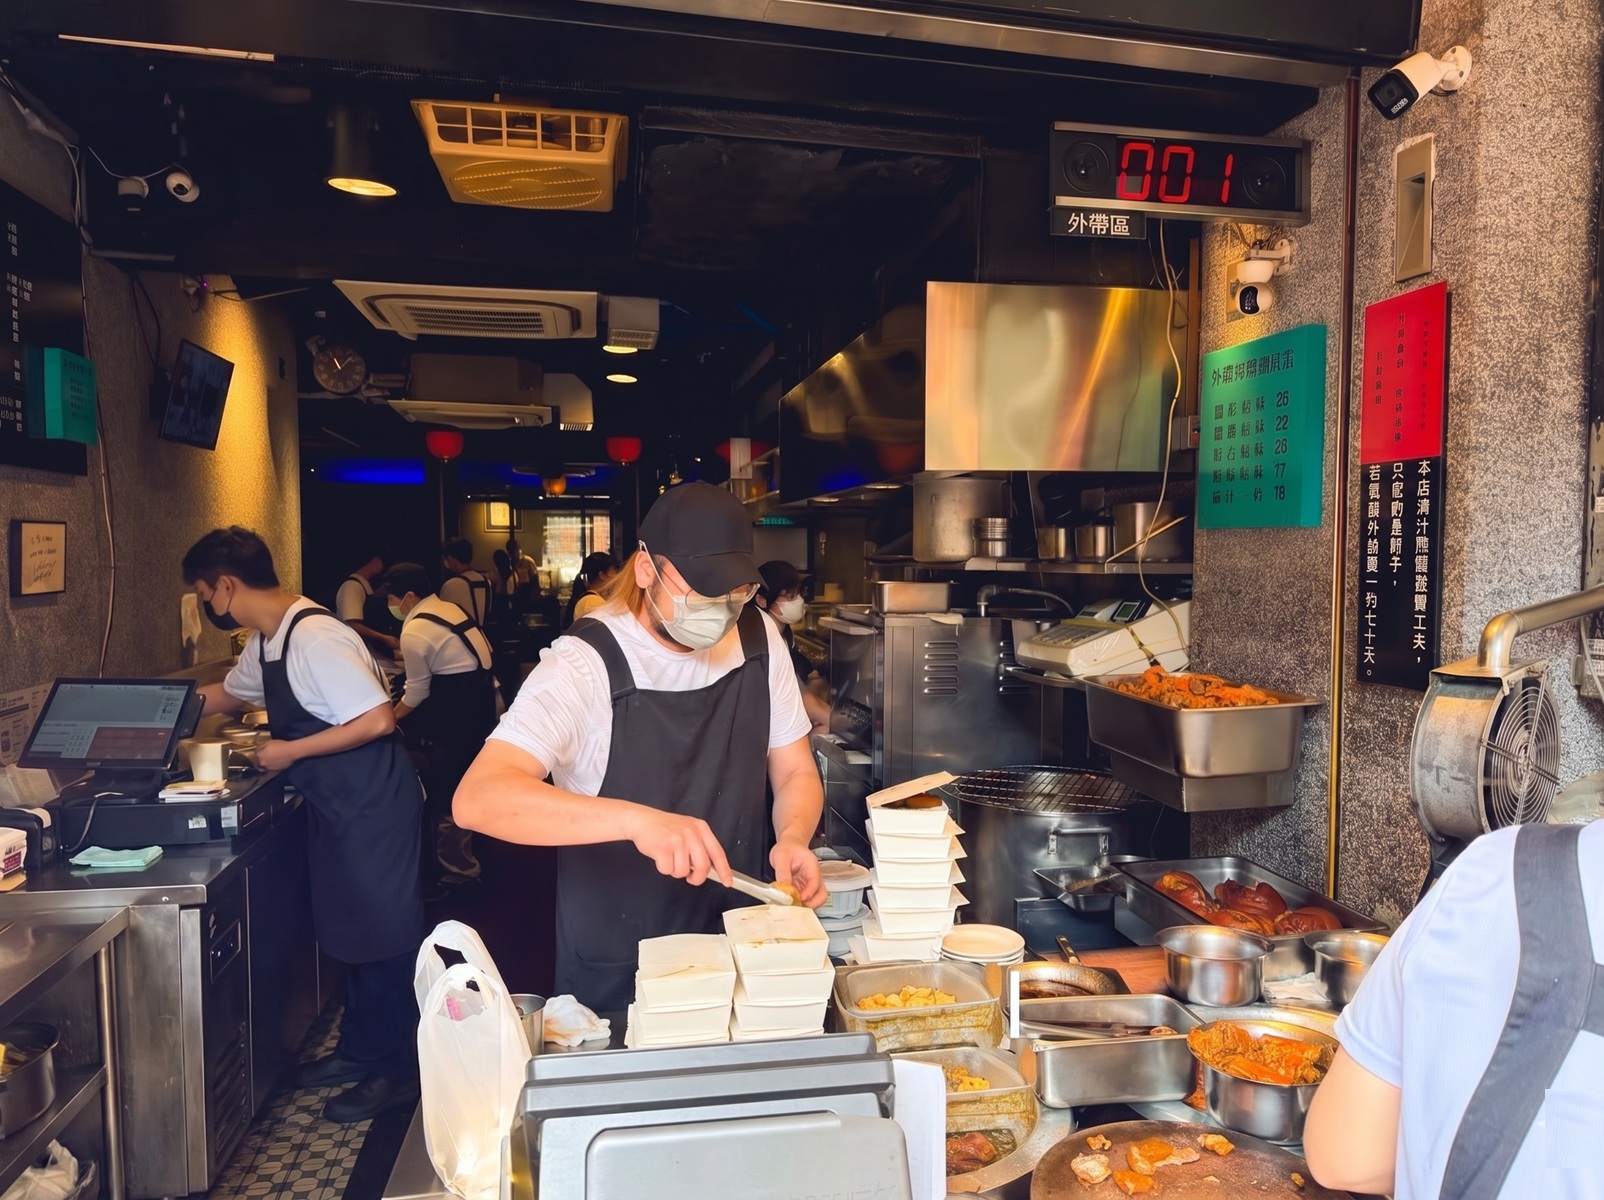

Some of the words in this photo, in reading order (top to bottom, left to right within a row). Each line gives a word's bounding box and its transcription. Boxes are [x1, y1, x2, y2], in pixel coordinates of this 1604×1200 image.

[1117, 142, 1234, 204] 001
[1067, 212, 1131, 236] 外帶區
[1276, 390, 1289, 408] 26
[1275, 414, 1289, 431] 22
